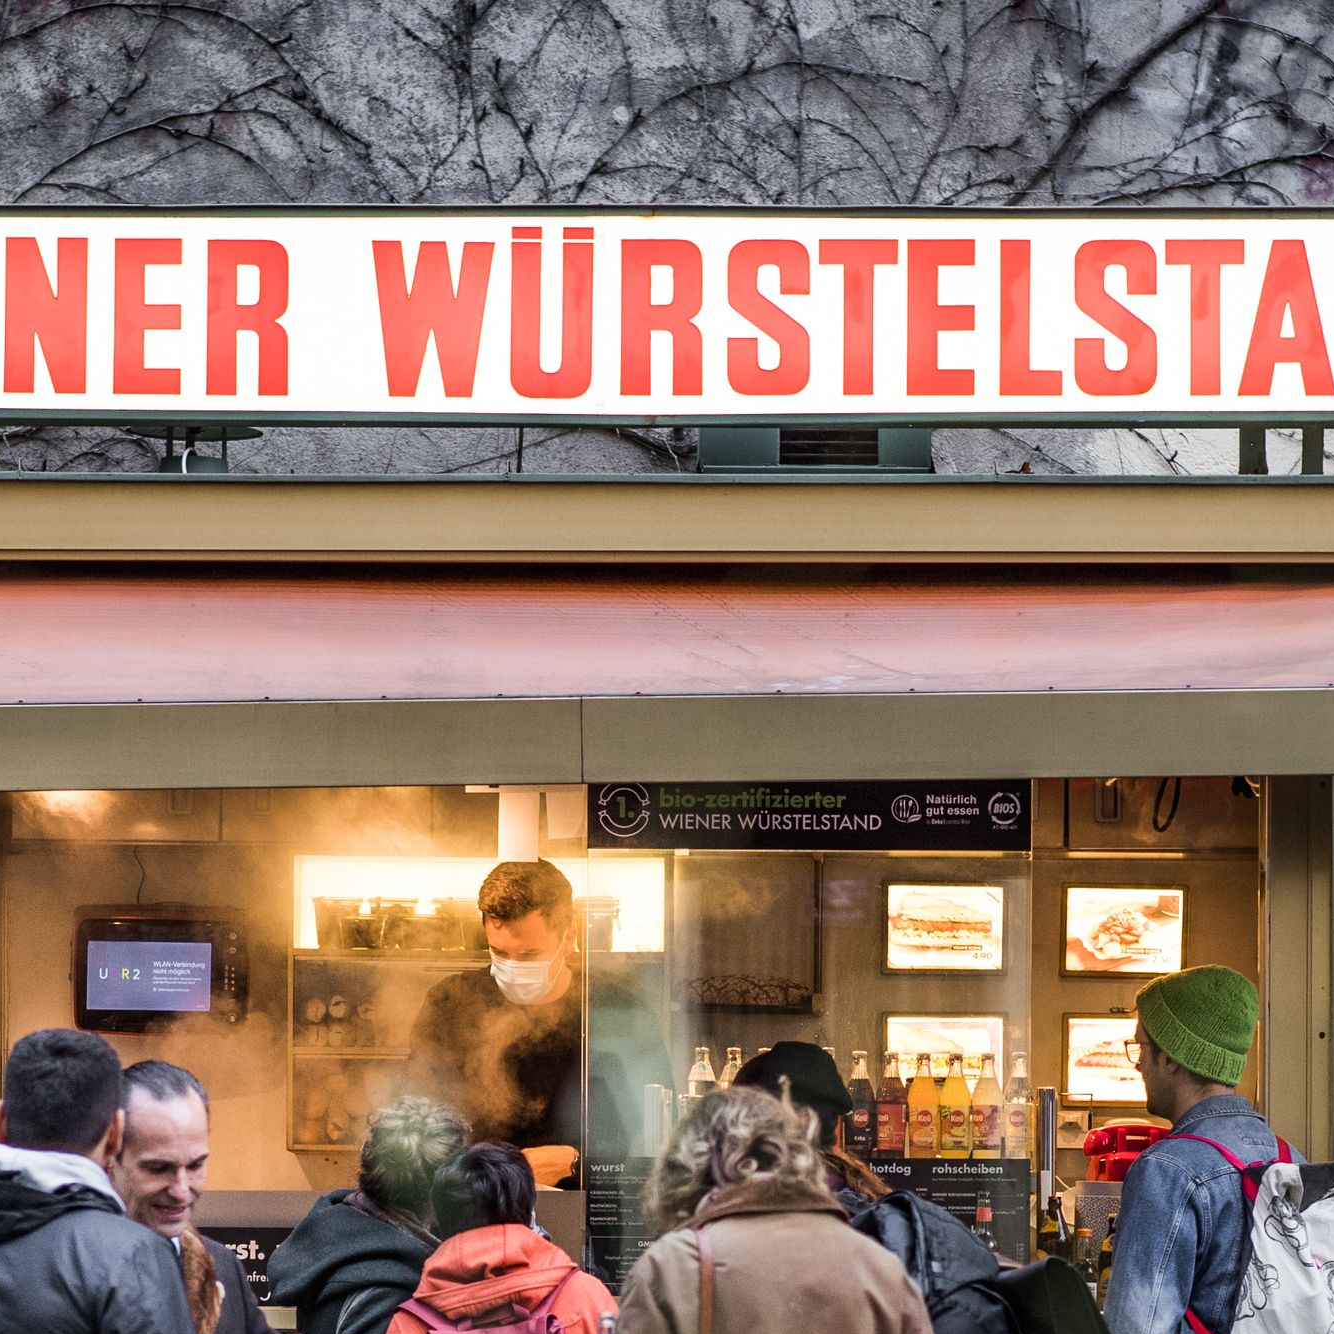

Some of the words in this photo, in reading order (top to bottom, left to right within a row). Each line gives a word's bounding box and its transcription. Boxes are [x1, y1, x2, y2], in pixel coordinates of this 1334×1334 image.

[659, 786, 847, 809] bio-zertifizierter
[926, 794, 977, 804] Natürlich
[617, 796, 635, 818] 1.
[926, 807, 945, 817] gut
[947, 807, 980, 815] essen
[993, 803, 1015, 814] BIOS
[659, 813, 731, 830] WIENER
[737, 810, 883, 831] WÜRSTELSTAND
[153, 961, 205, 969] WLAN-Verbindung
[590, 1162, 625, 1172] wurst
[870, 1163, 912, 1175] hotdog
[932, 1163, 1003, 1174] rohscheiben
